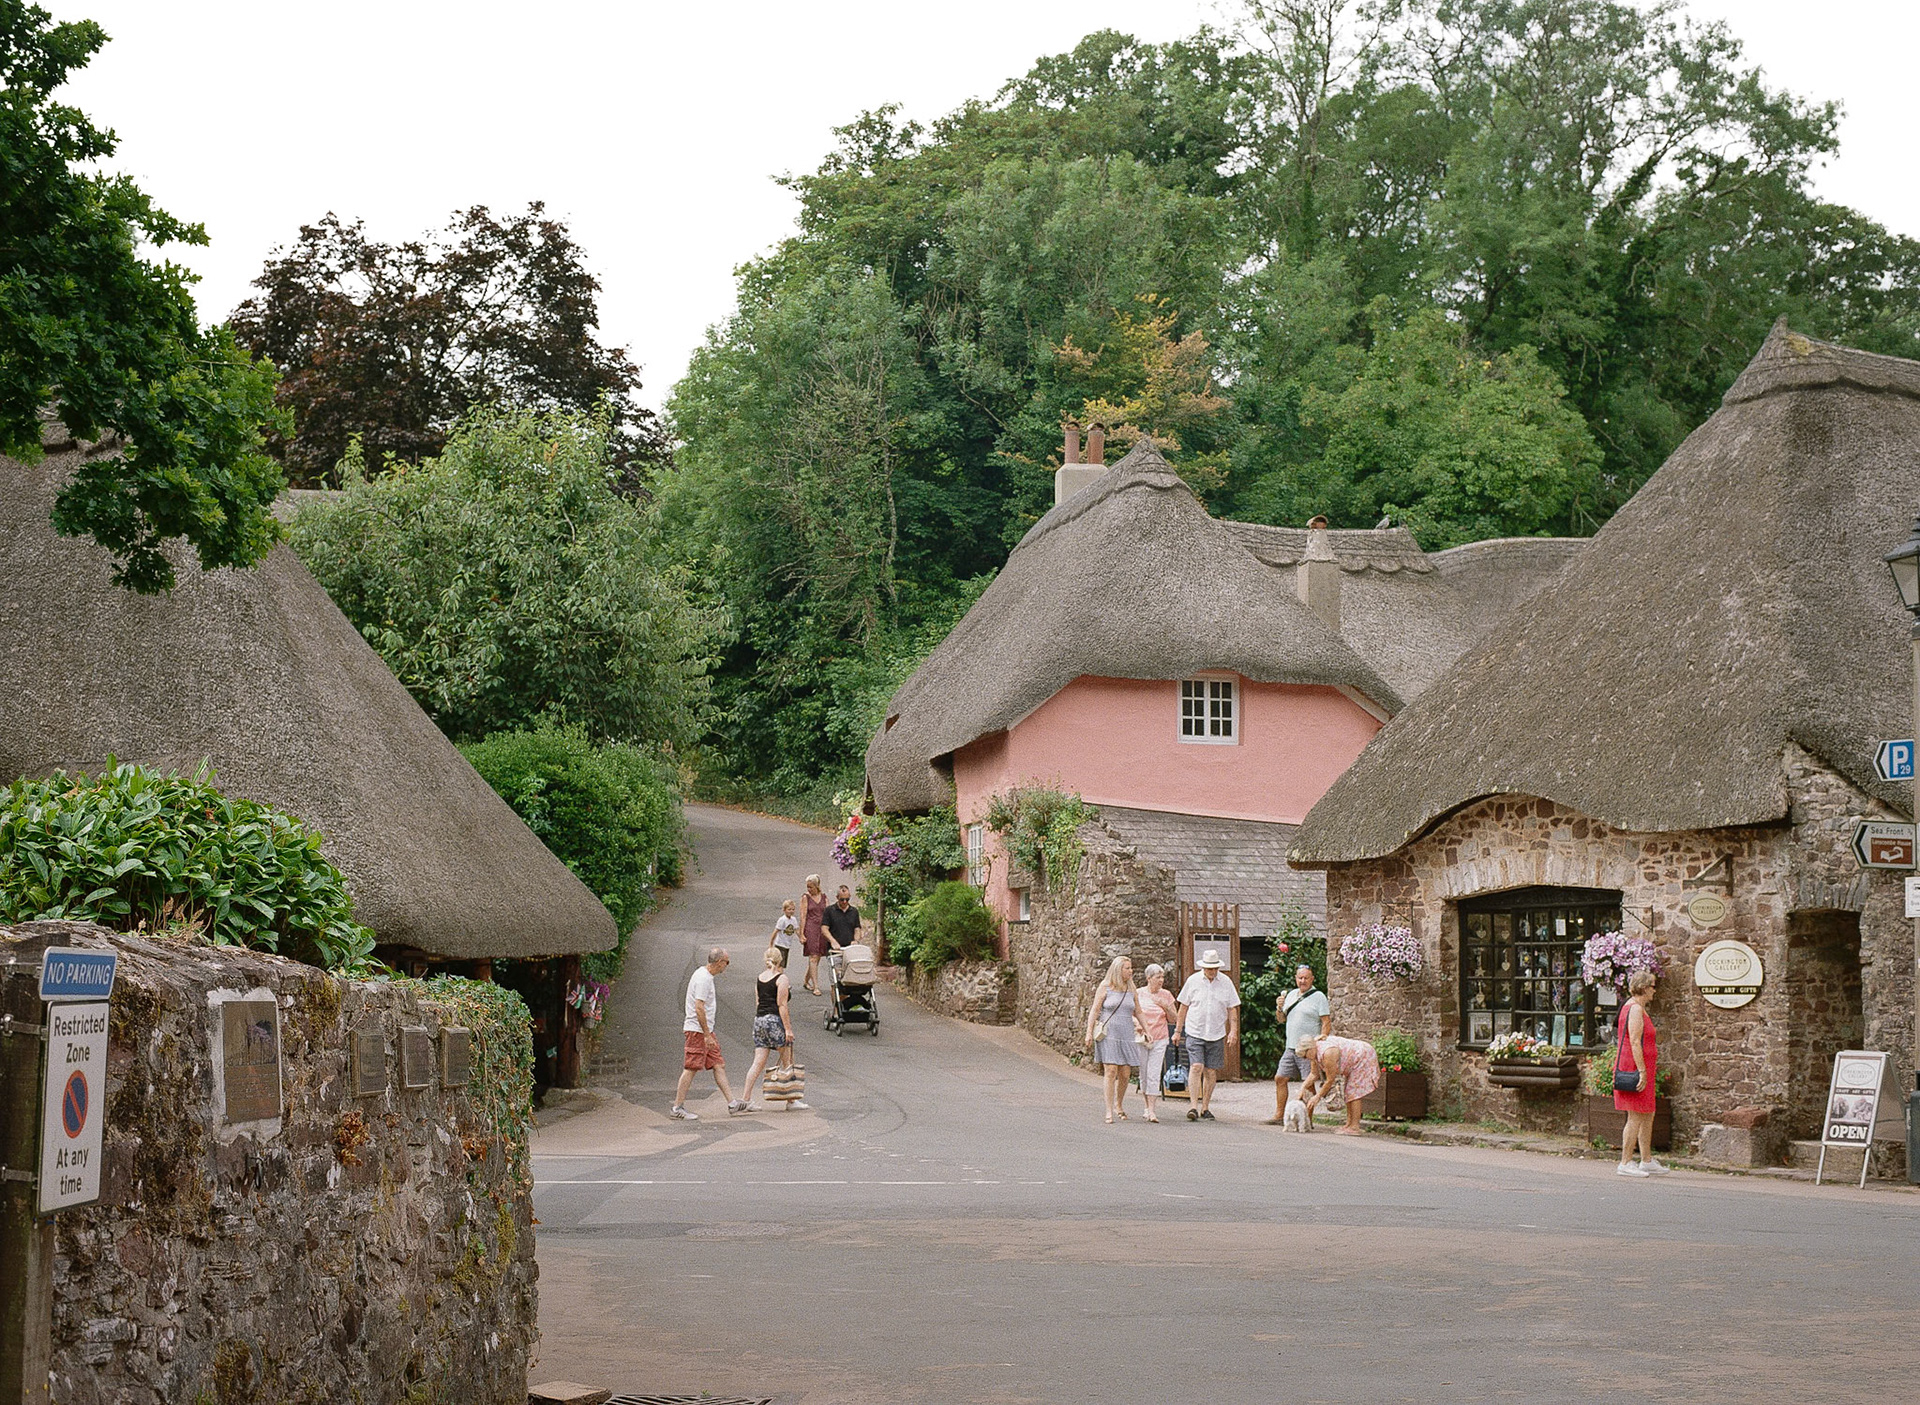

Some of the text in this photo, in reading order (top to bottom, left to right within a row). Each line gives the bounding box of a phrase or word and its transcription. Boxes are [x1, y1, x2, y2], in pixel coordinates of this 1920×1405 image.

[1892, 745, 1909, 776] P
[1900, 764, 1911, 775] 29
[1870, 826, 1883, 835] Sea
[1886, 827, 1904, 836] Front
[47, 962, 111, 985] NO PARKING
[1701, 986, 1757, 994] CRAFT ART GIFTS
[53, 1013, 105, 1037] Restricted
[66, 1043, 90, 1064] Zone
[1829, 1125, 1868, 1140] OPEN
[56, 1148, 89, 1169] At any
[60, 1174, 82, 1196] time
